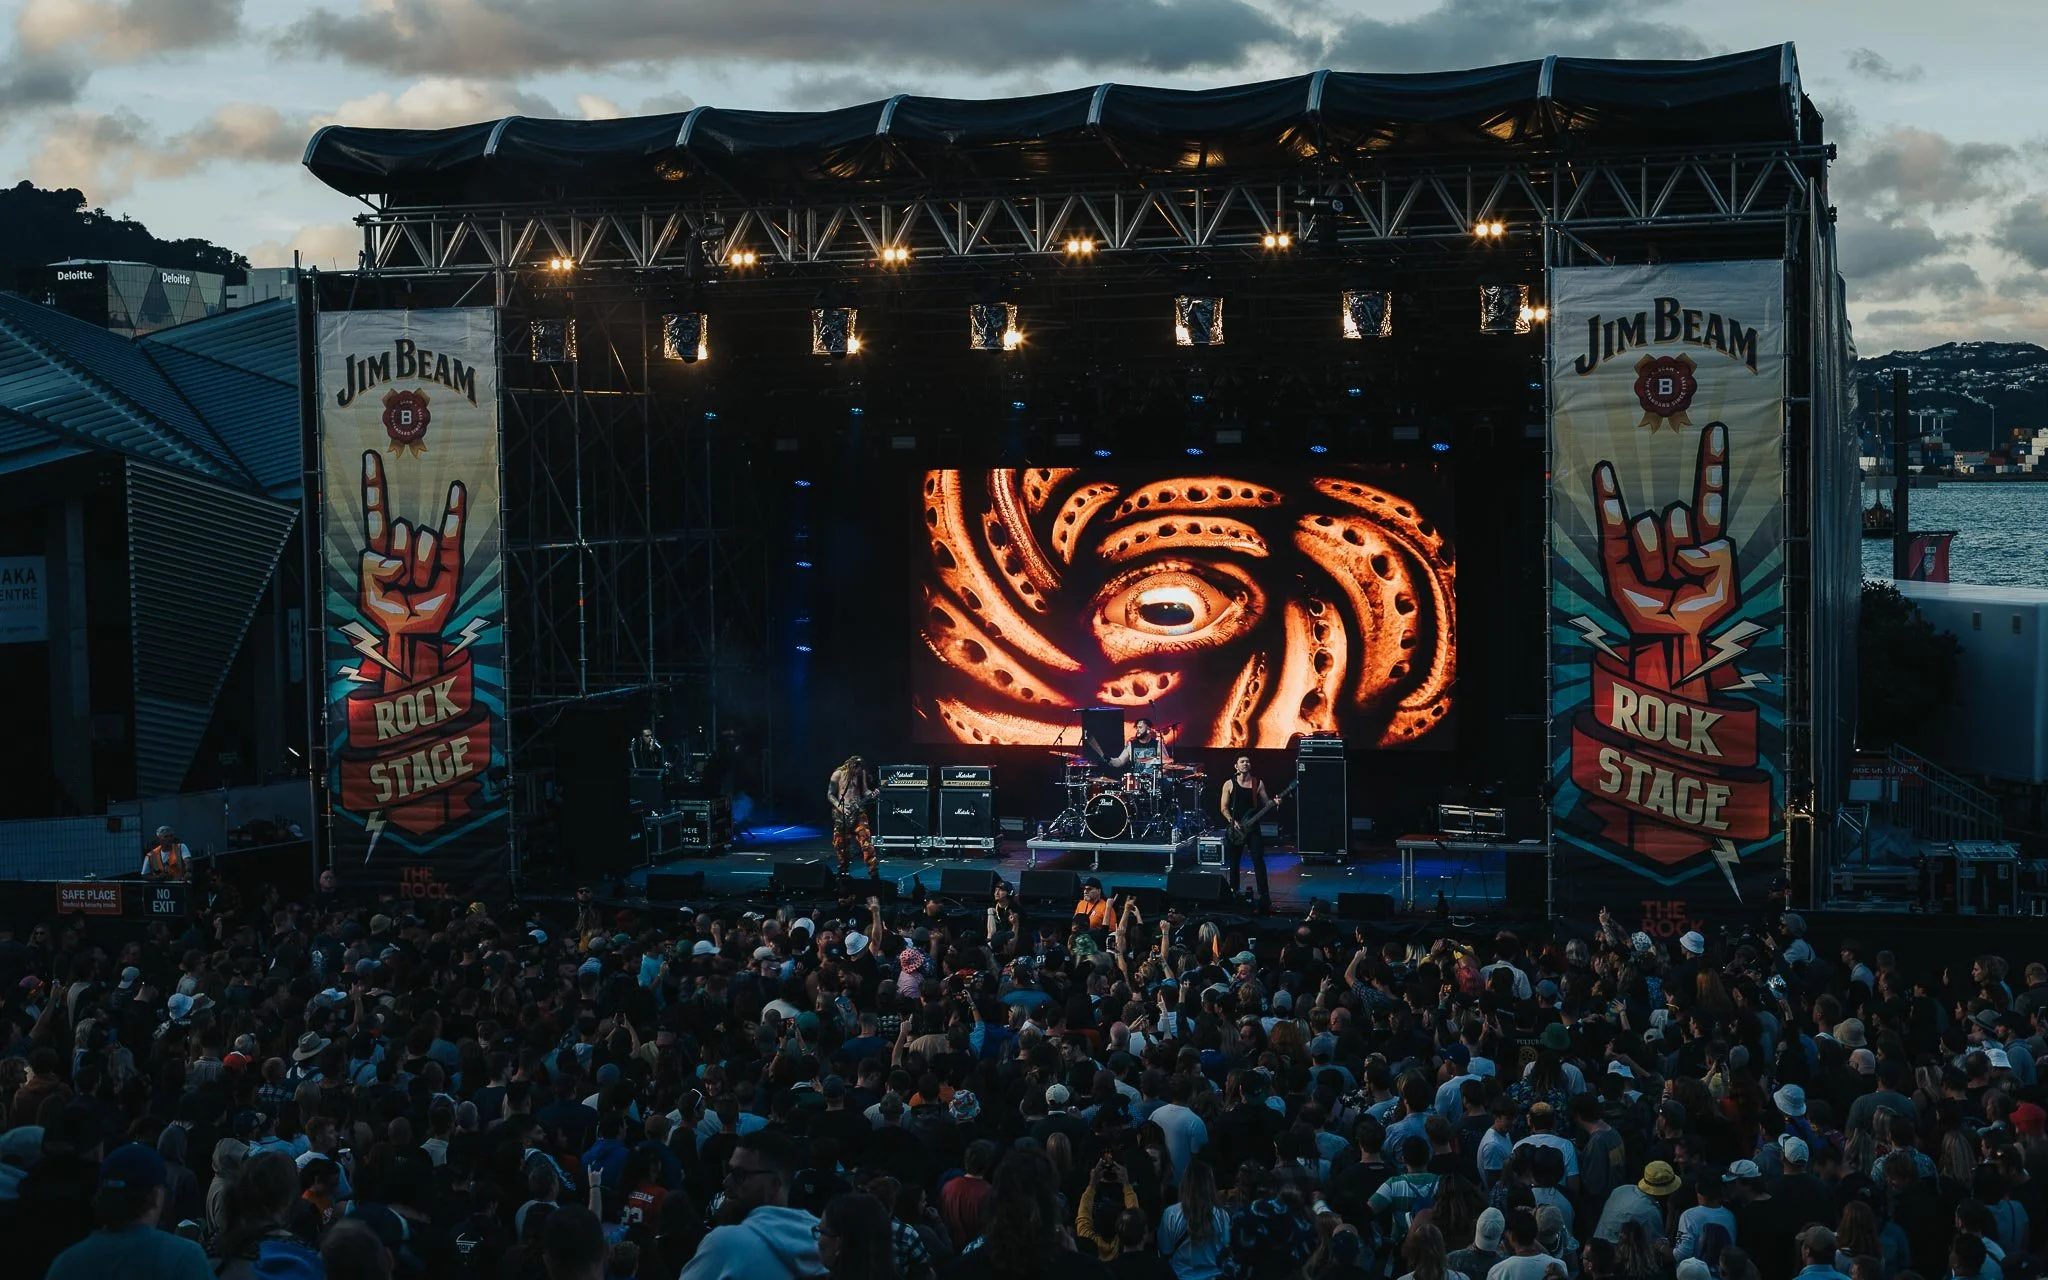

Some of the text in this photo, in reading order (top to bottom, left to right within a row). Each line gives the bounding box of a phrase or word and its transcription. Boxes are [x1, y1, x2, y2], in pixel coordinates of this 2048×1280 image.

[162, 272, 190, 285] Deloitte
[1574, 296, 1759, 377] JIM BEAM
[336, 338, 478, 408] JIM BEAM
[1658, 378, 1673, 395] B
[400, 409, 412, 425] B
[1, 567, 37, 585] AKA
[373, 675, 463, 742] ROCK
[1611, 681, 1726, 757] ROCK
[369, 735, 474, 804] STAGE
[956, 771, 977, 779] Marshall
[1598, 747, 1732, 832] STAGE
[401, 866, 435, 883] THE
[62, 889, 116, 901] SAFE PLACE
[156, 888, 170, 900] NO
[401, 882, 450, 900] ROCK
[152, 900, 176, 913] EXIT
[1641, 900, 1687, 919] THE
[1641, 918, 1705, 938] ROCK
